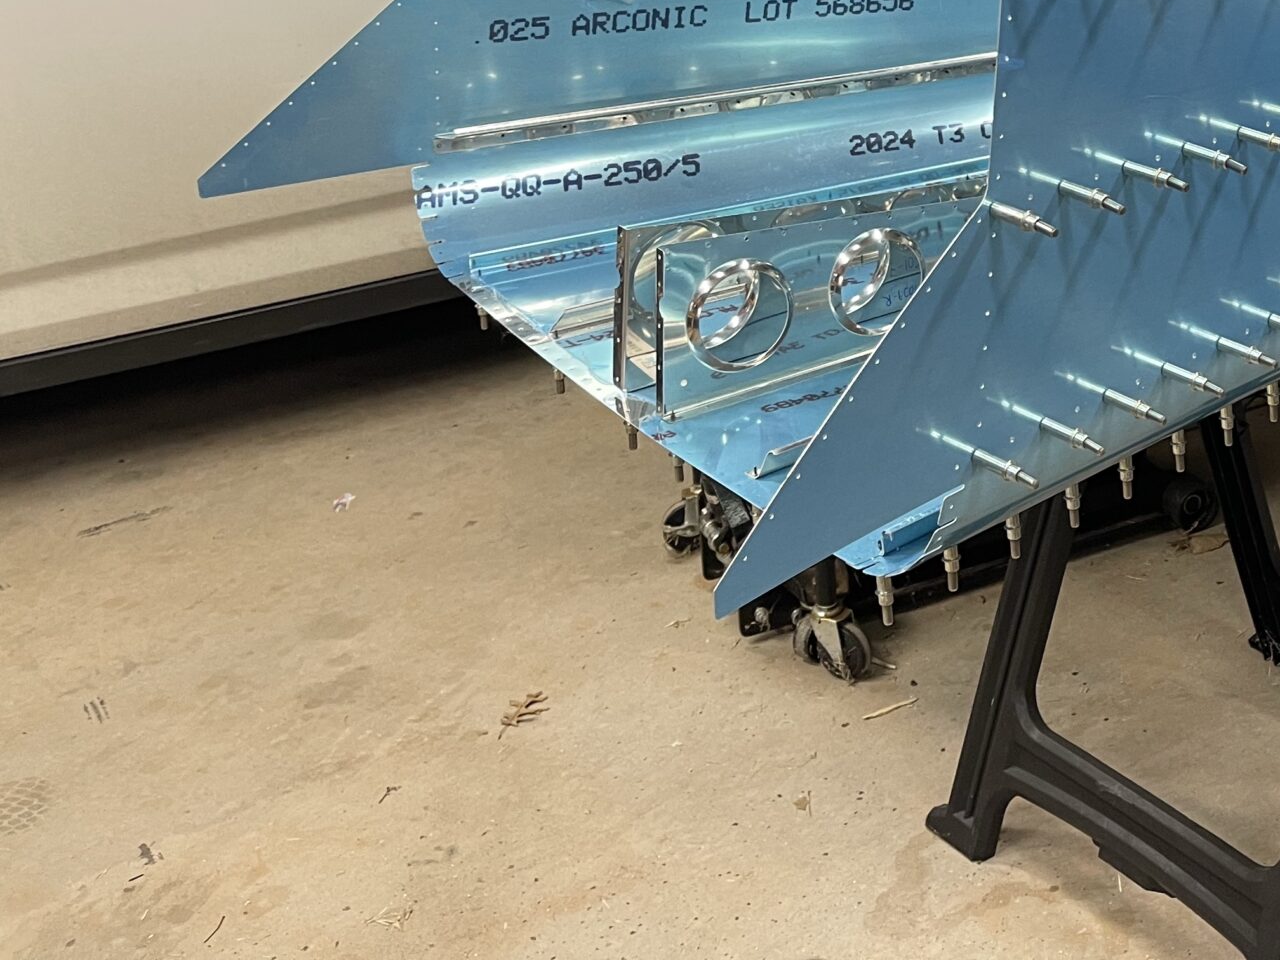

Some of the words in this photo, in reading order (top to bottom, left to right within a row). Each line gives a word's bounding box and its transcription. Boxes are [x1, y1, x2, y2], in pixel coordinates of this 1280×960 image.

[474, 15, 551, 44] .025
[571, 4, 709, 37] ARCONIC
[416, 153, 700, 210] AMS-QQ-A-250/5
[849, 128, 916, 156] 2024
[932, 122, 965, 145] T3
